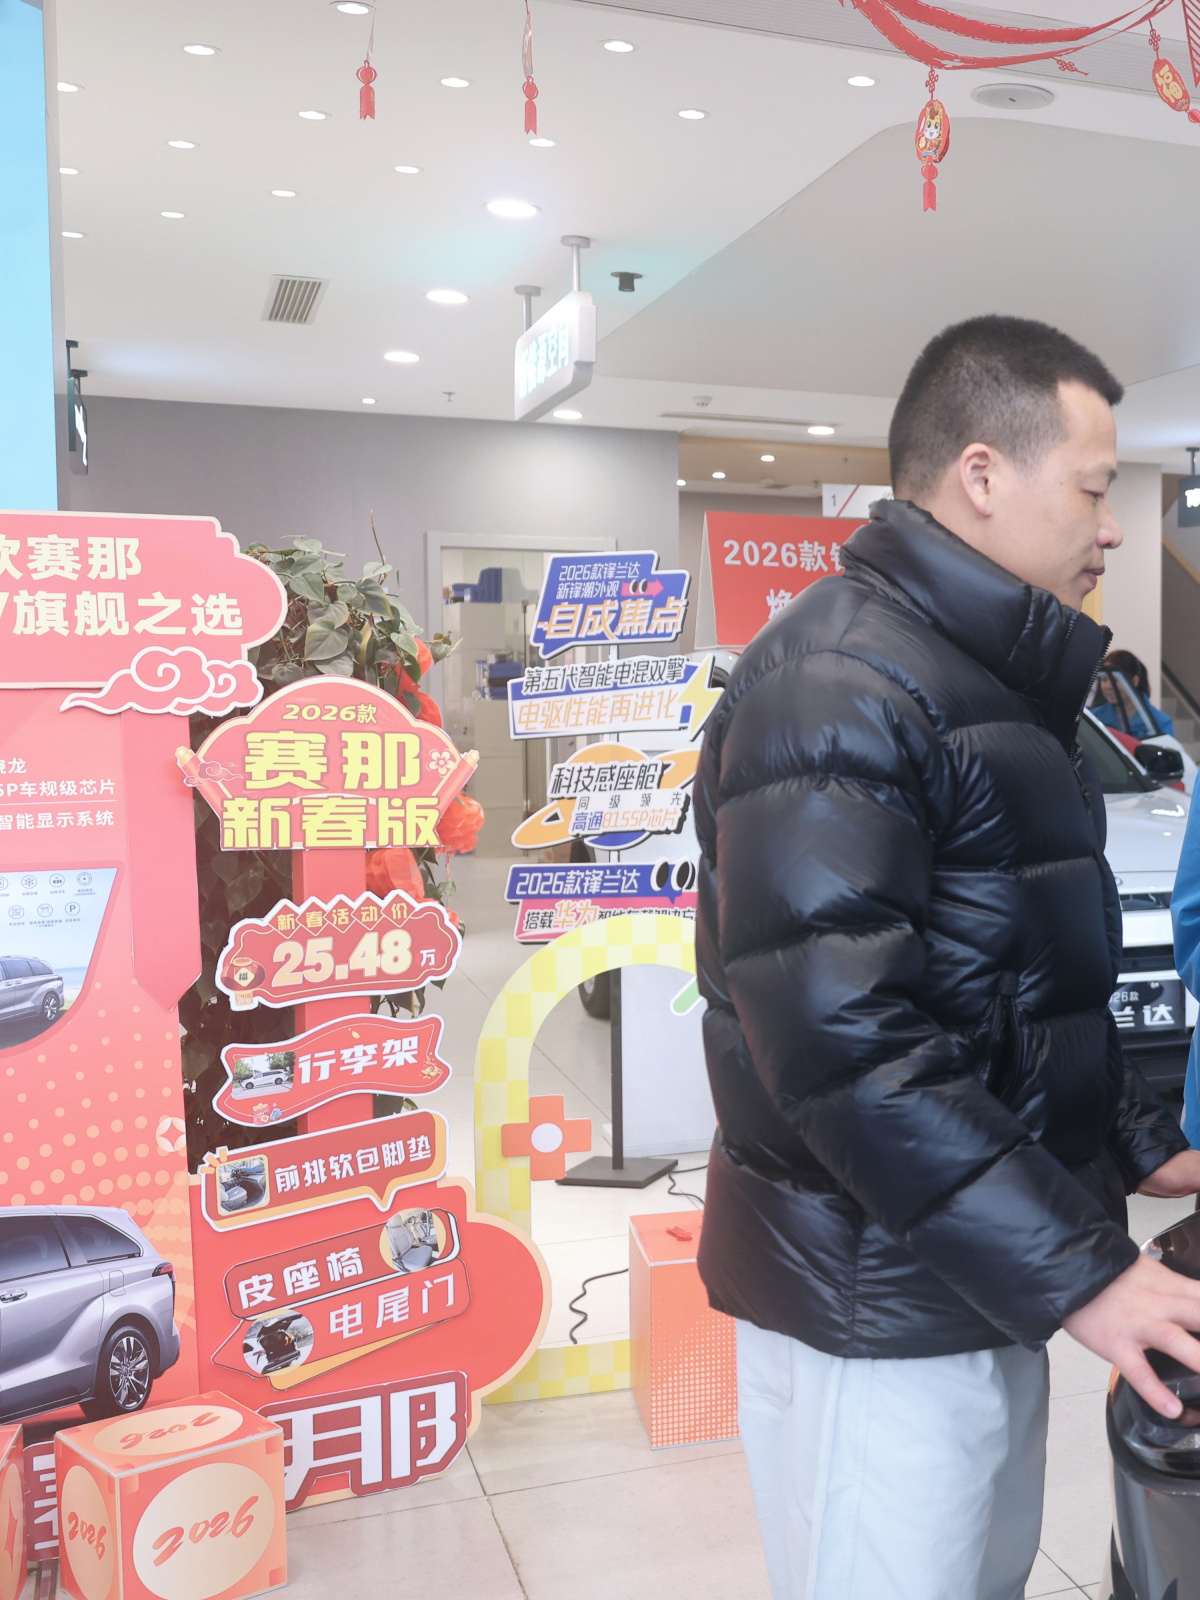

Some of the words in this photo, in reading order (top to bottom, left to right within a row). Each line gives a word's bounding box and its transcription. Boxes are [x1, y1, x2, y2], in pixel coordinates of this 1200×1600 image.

[556, 581, 619, 599] 新锋潮外观
[559, 562, 641, 581] 2026款锋兰达
[0, 590, 244, 637] 旗舰之选
[540, 596, 687, 640] 自成焦点
[523, 657, 683, 693] 第五代智能电混双擎
[282, 704, 376, 723] 2026款
[518, 690, 678, 731] 电驱性能再进化
[244, 730, 420, 790] 赛那
[551, 763, 658, 795] 科技感座舱
[222, 797, 441, 848] 新春版
[516, 869, 641, 895] 2026款锋兰达
[277, 902, 408, 931] 新春活动价
[1110, 991, 1139, 1002] 26款
[298, 1035, 419, 1084] 行李架
[275, 1135, 432, 1193] 前排软包脚垫
[237, 1247, 363, 1309] 皮座椅
[329, 1273, 454, 1339] 电尾门
[67, 1511, 107, 1560] 2026
[152, 1495, 259, 1567] 2026
